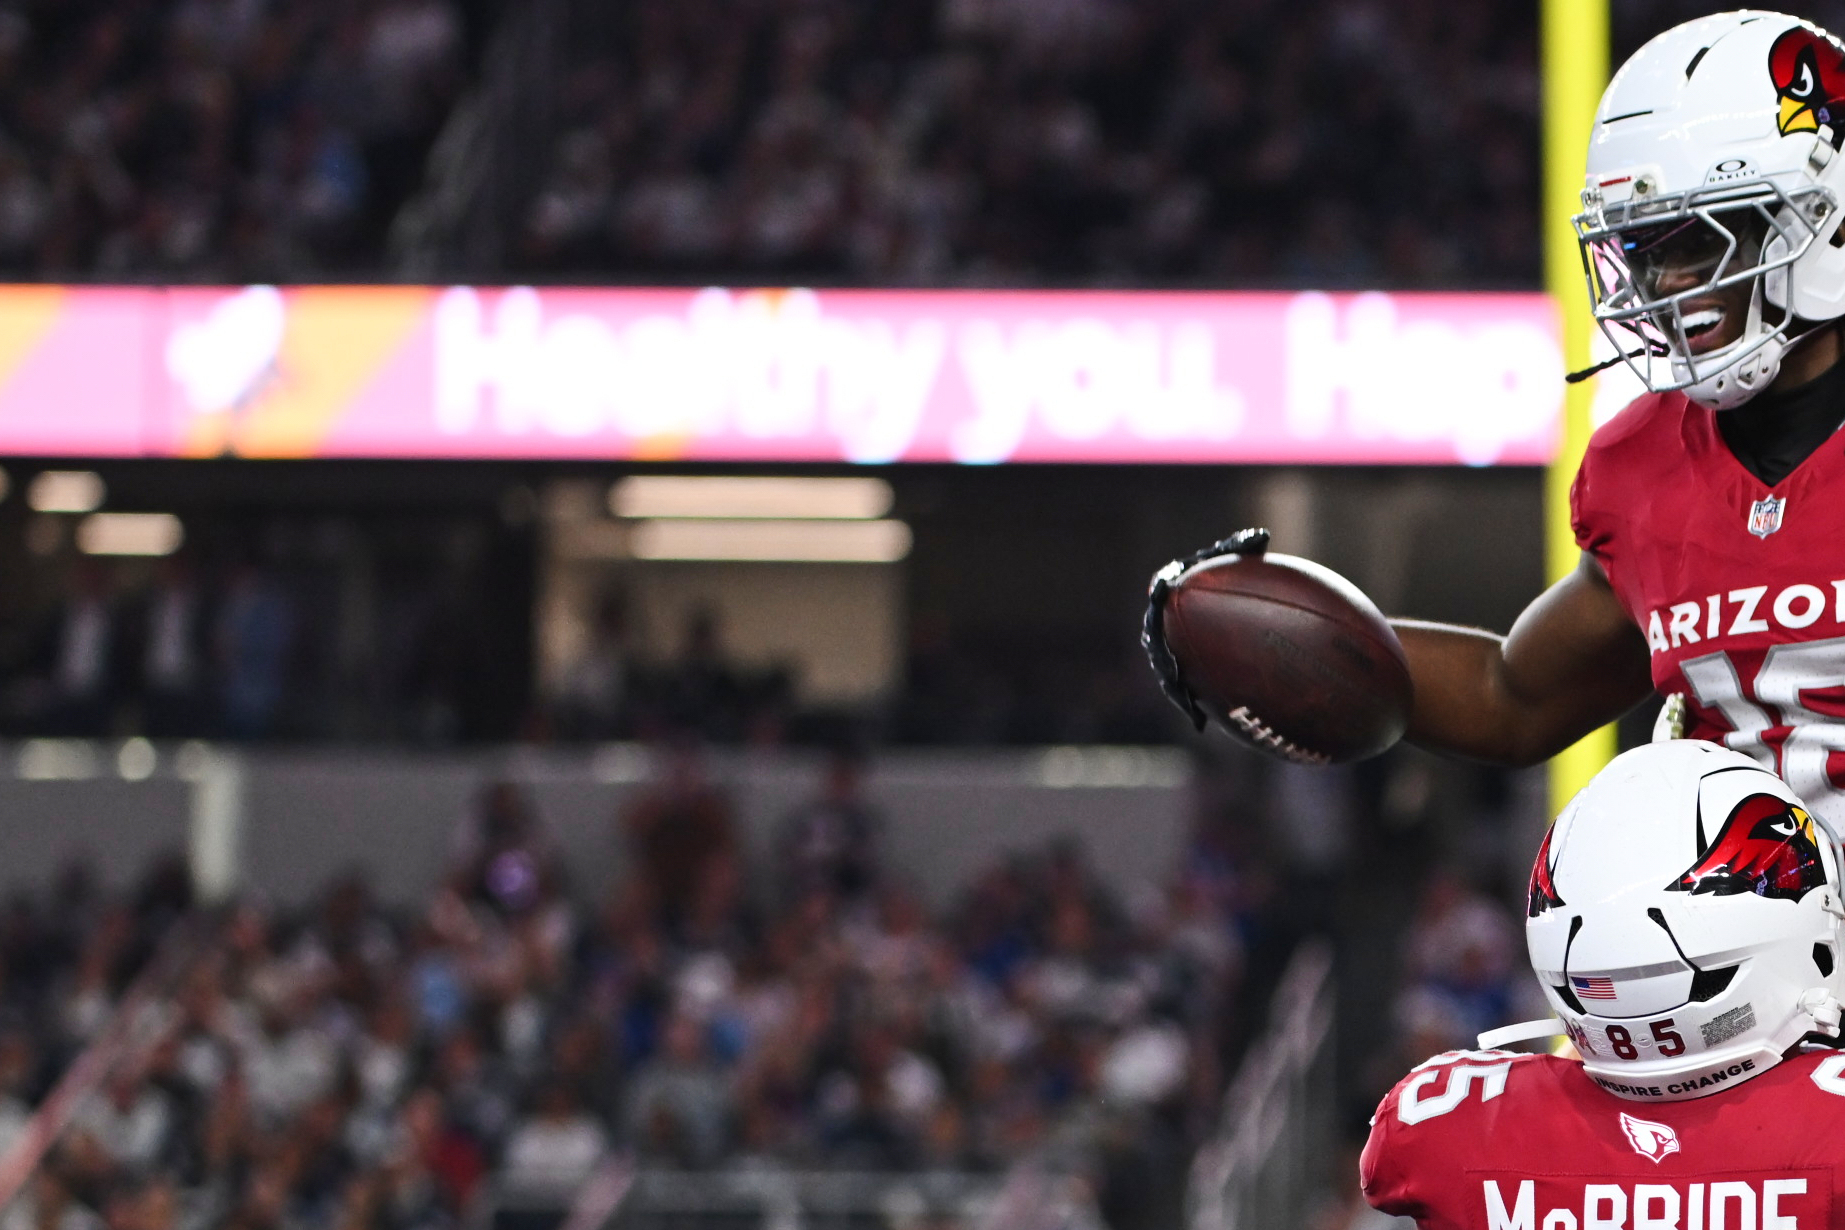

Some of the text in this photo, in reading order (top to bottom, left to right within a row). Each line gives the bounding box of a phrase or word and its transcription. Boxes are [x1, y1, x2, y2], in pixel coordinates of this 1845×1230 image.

[434, 285, 1567, 466] Healthy you. Hap
[1595, 1059, 1756, 1096] INSPIRE CHANGE
